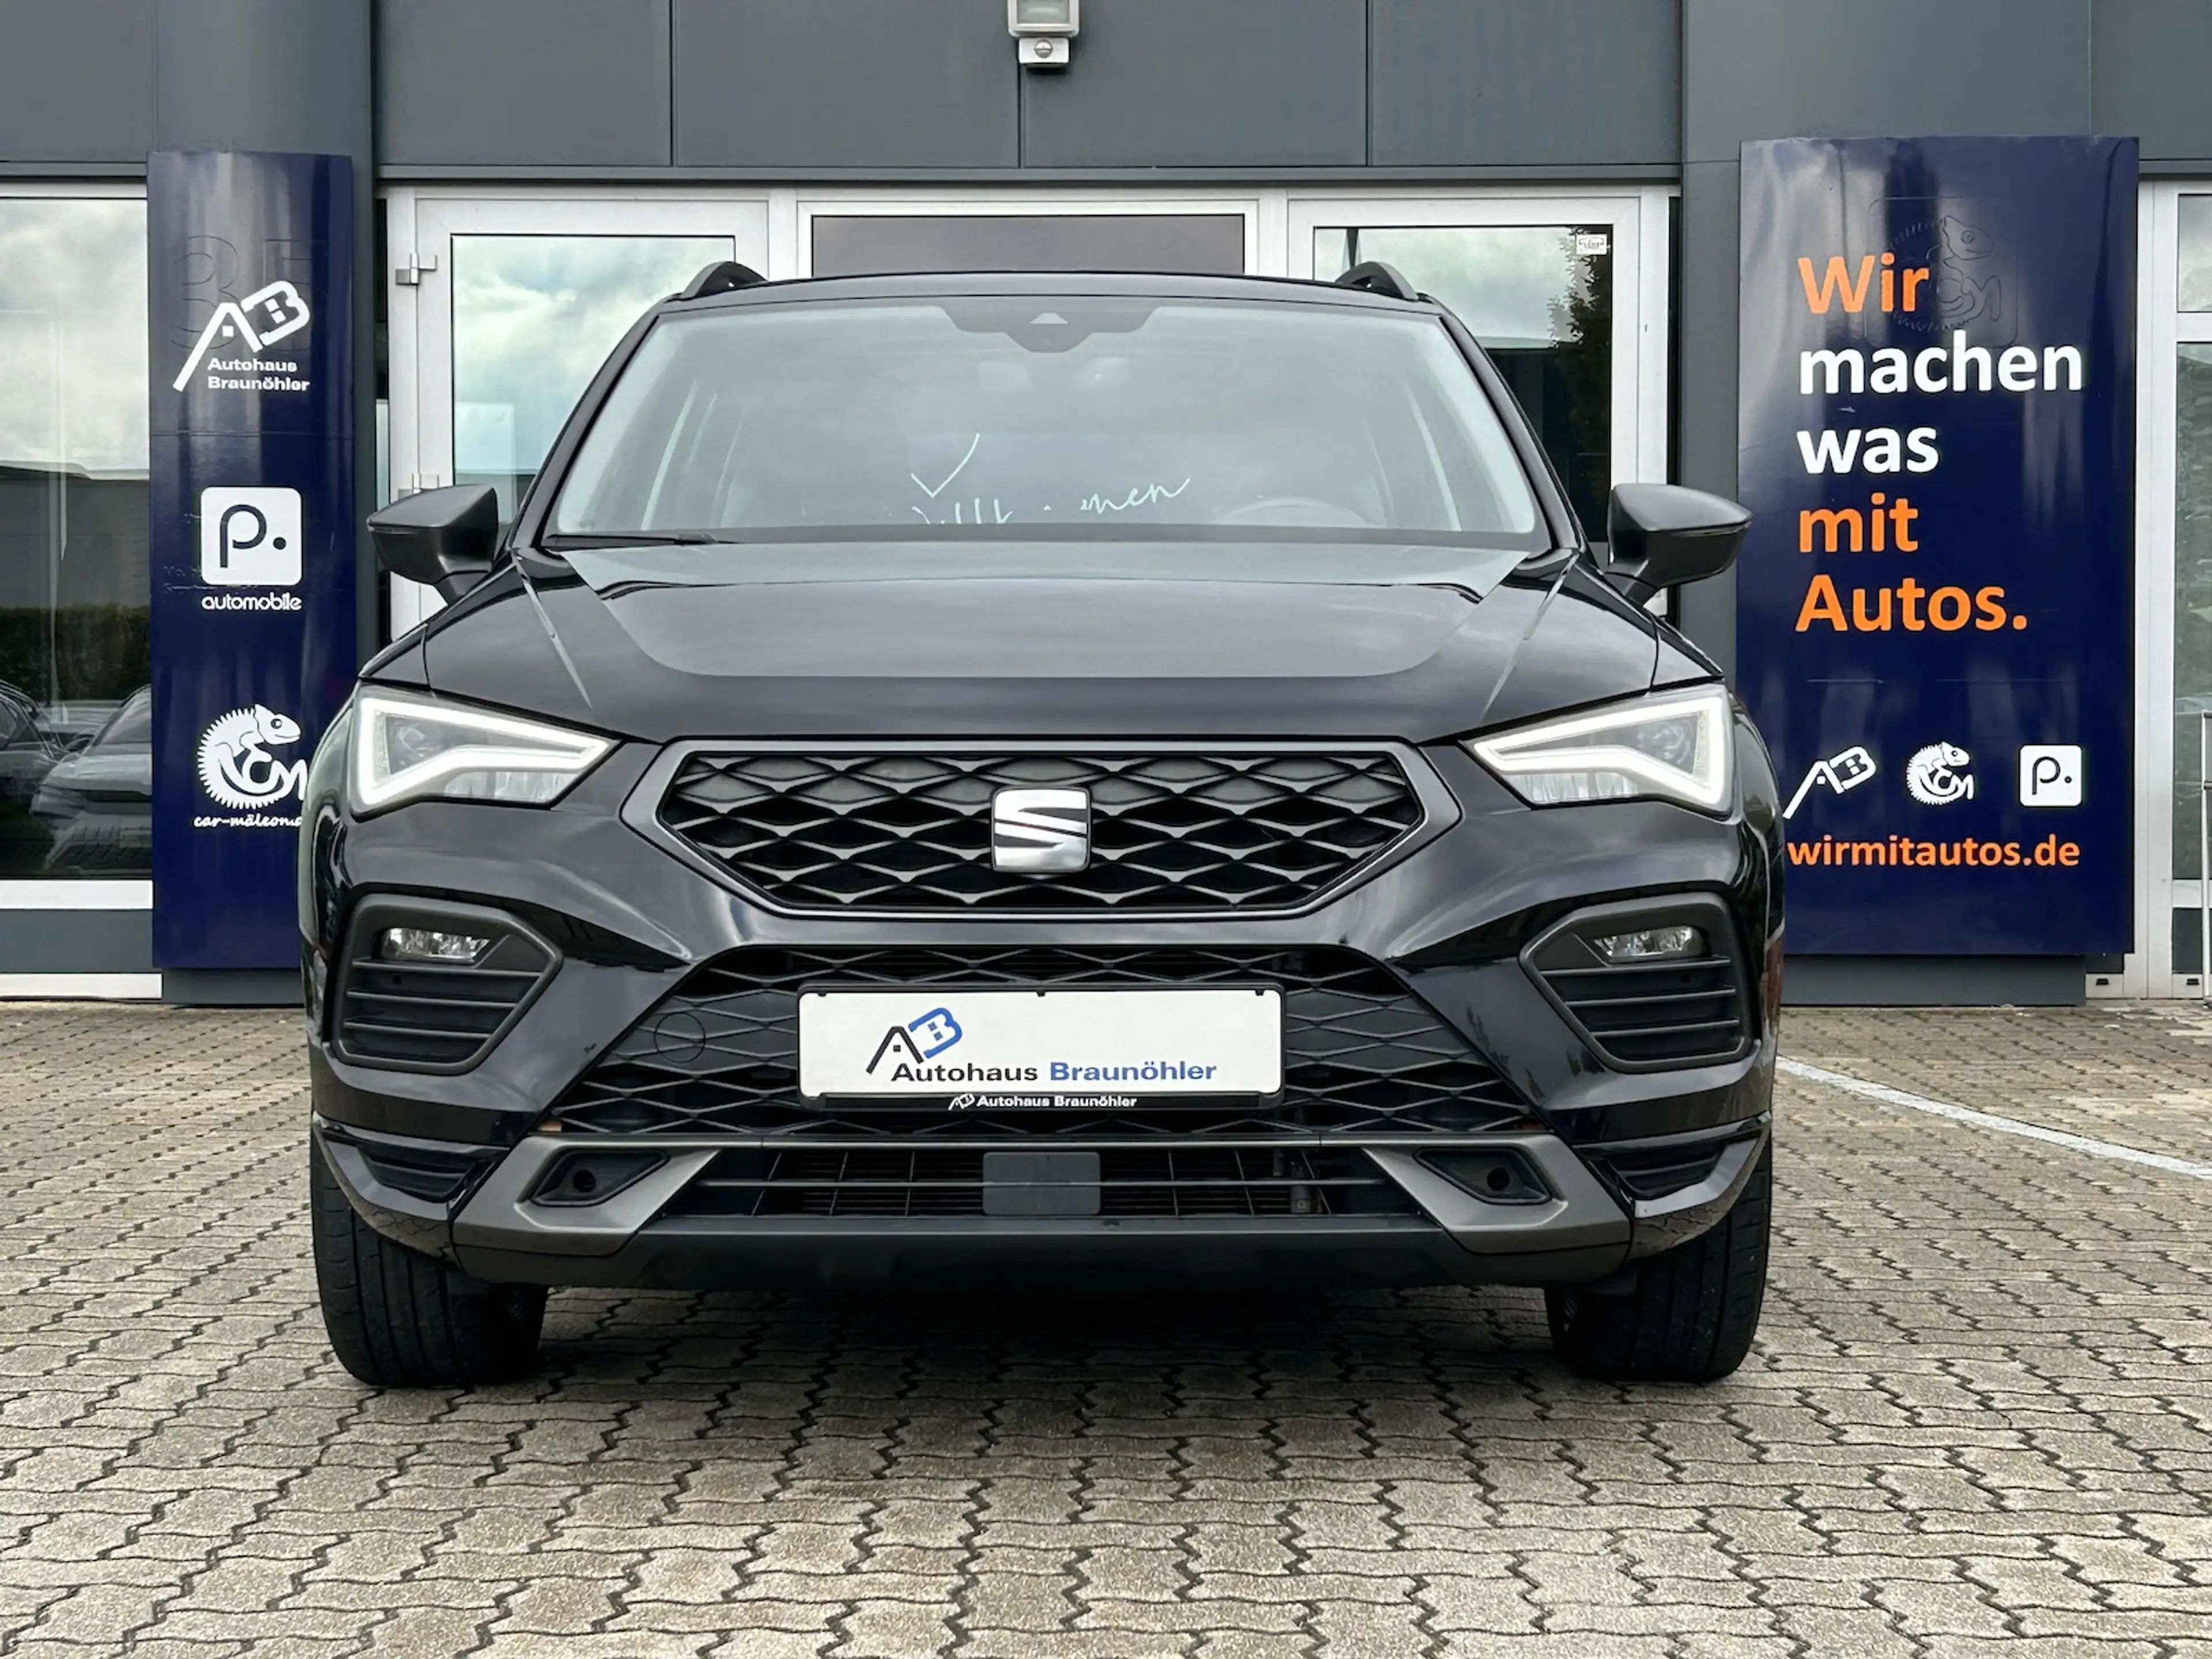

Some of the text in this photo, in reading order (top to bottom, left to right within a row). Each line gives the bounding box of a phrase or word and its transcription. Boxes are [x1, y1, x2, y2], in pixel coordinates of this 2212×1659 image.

[1798, 252, 1929, 314] Wir
[207, 357, 298, 372] Autohaus
[1800, 329, 2082, 395] machen
[207, 376, 310, 391] Braunöhler
[1796, 426, 1940, 474] was
[1798, 493, 1918, 553] mit
[202, 592, 302, 611] automobile
[1795, 574, 2028, 632] Autos.
[1787, 834, 2081, 866] wirmitautos.de
[891, 1061, 1217, 1082] Autohaus Braunöhler
[976, 1095, 1050, 1107] Autohaus
[1054, 1094, 1138, 1107] Braunöhler
